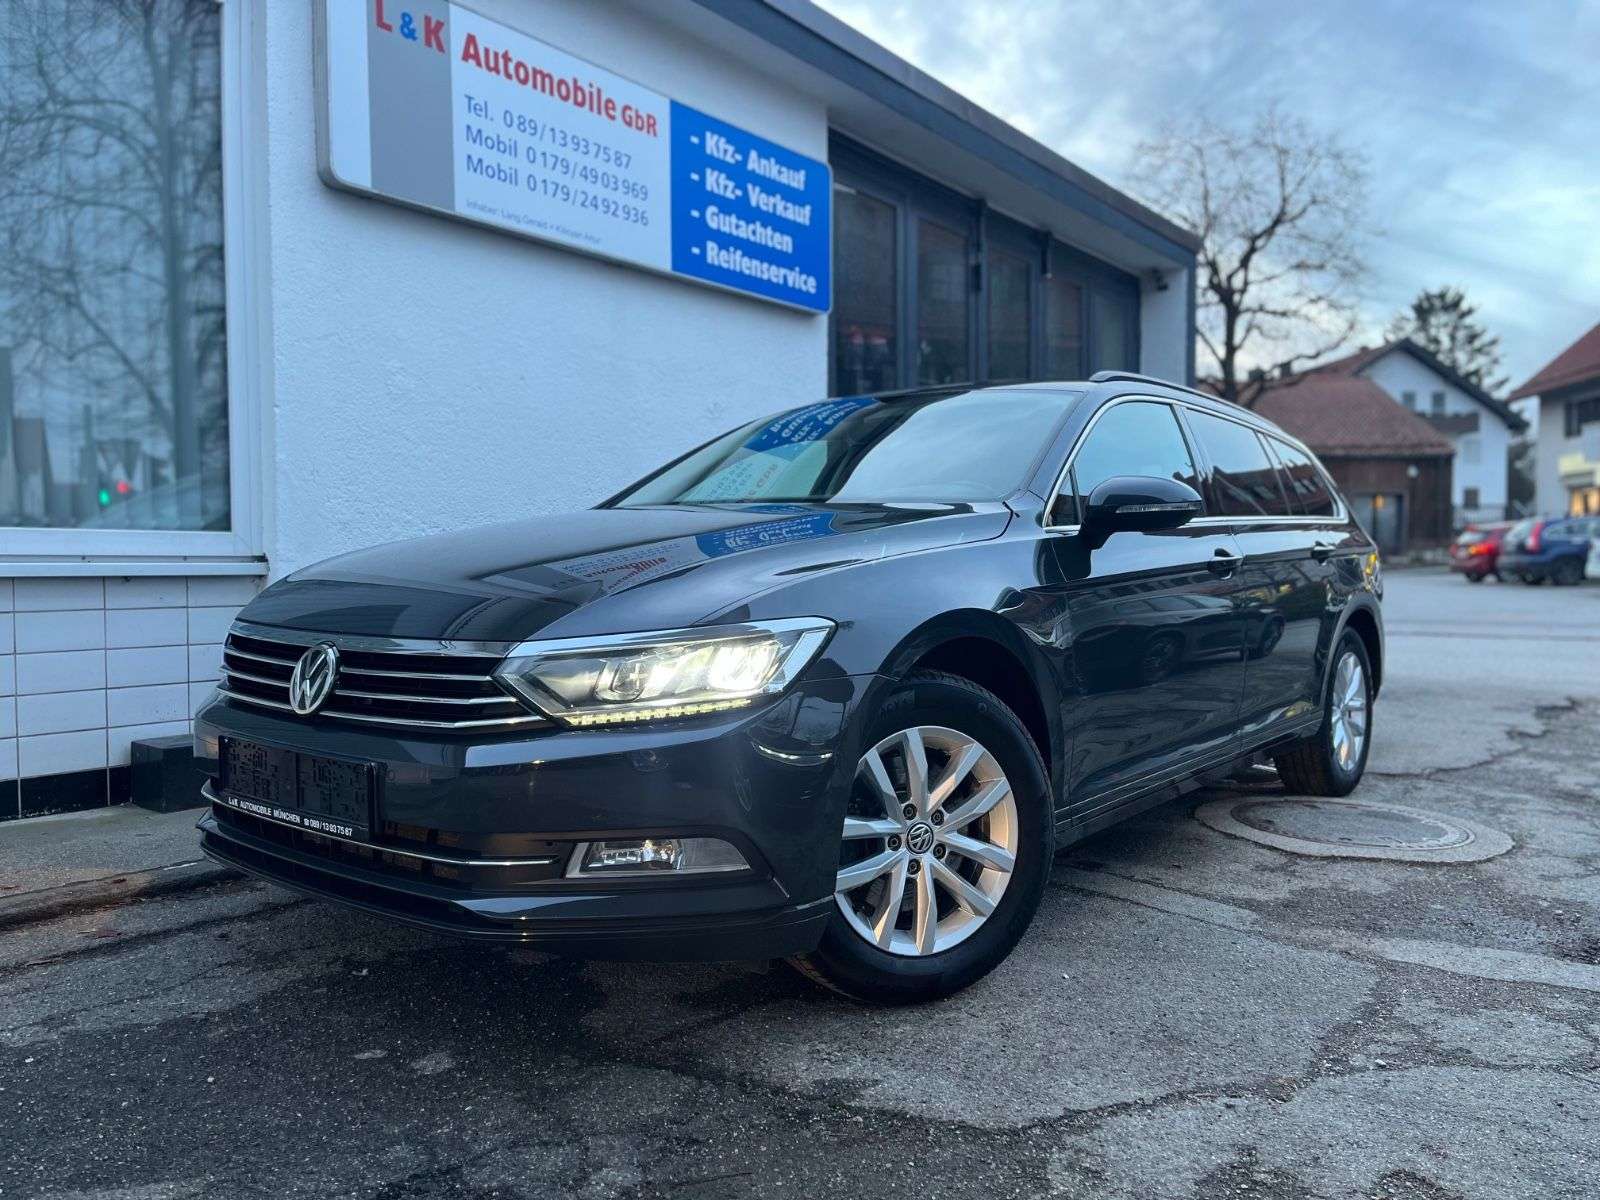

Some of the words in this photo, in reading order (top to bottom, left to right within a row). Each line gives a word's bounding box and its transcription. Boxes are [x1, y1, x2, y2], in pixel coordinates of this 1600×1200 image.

[376, 0, 393, 32] L
[400, 12, 418, 41] &
[424, 15, 446, 54] K
[461, 33, 616, 121] Automobile
[621, 104, 659, 137] GbR
[465, 95, 494, 121] Tel.
[466, 124, 518, 158] Mobil
[705, 131, 742, 164] Kfz-
[747, 149, 806, 191] Ankauf
[467, 154, 519, 186] Mobil
[705, 167, 743, 200] Kfz-
[747, 182, 812, 226] Verkauf
[705, 205, 793, 254] Gutachten
[706, 239, 817, 294] Reifenservice
[240, 801, 272, 816] AUTOMOBILE
[273, 808, 301, 824] MÜNCHEN
